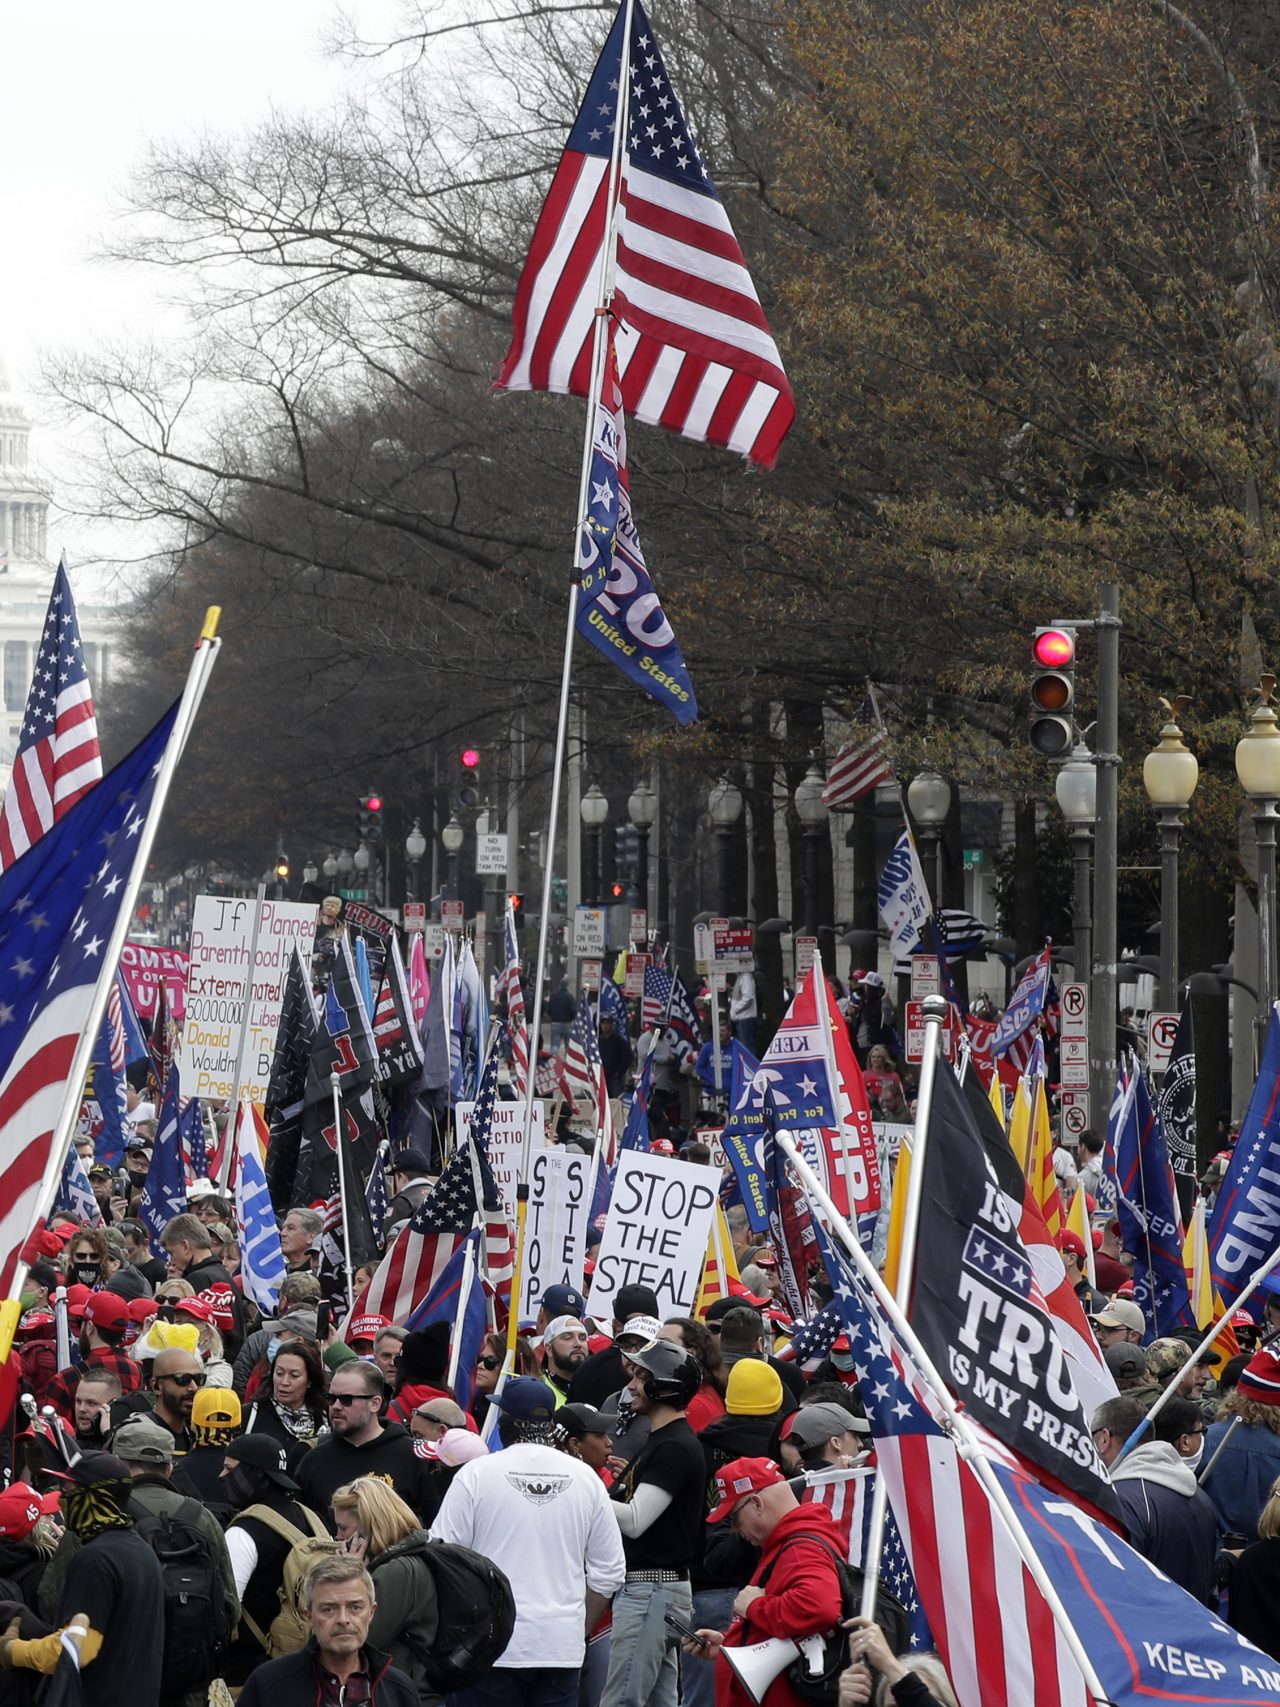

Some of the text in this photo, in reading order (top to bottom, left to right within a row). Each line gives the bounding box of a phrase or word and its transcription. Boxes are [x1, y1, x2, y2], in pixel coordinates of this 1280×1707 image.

[587, 608, 690, 703] United States
[479, 855, 505, 863] ON RED
[484, 846, 502, 854] TURN
[213, 899, 320, 938] If Planned
[345, 900, 395, 941] TRUM
[576, 934, 602, 942] ON RED
[120, 945, 191, 974] OMEN
[190, 931, 281, 968] Parenthood
[187, 1022, 232, 1048] Donald
[857, 1109, 881, 1176] Donald
[614, 1170, 715, 1228] STOP
[747, 1172, 767, 1218] States
[977, 1180, 1011, 1234] IS
[1129, 1198, 1177, 1238] KEEP
[616, 1219, 681, 1260] THE
[595, 1255, 692, 1309] STEAL
[957, 1270, 1080, 1412] TRU
[972, 1366, 1022, 1419] MY
[1022, 1399, 1114, 1487] PRESID
[25, 1503, 41, 1522] 45
[1141, 1639, 1227, 1680] KEEP
